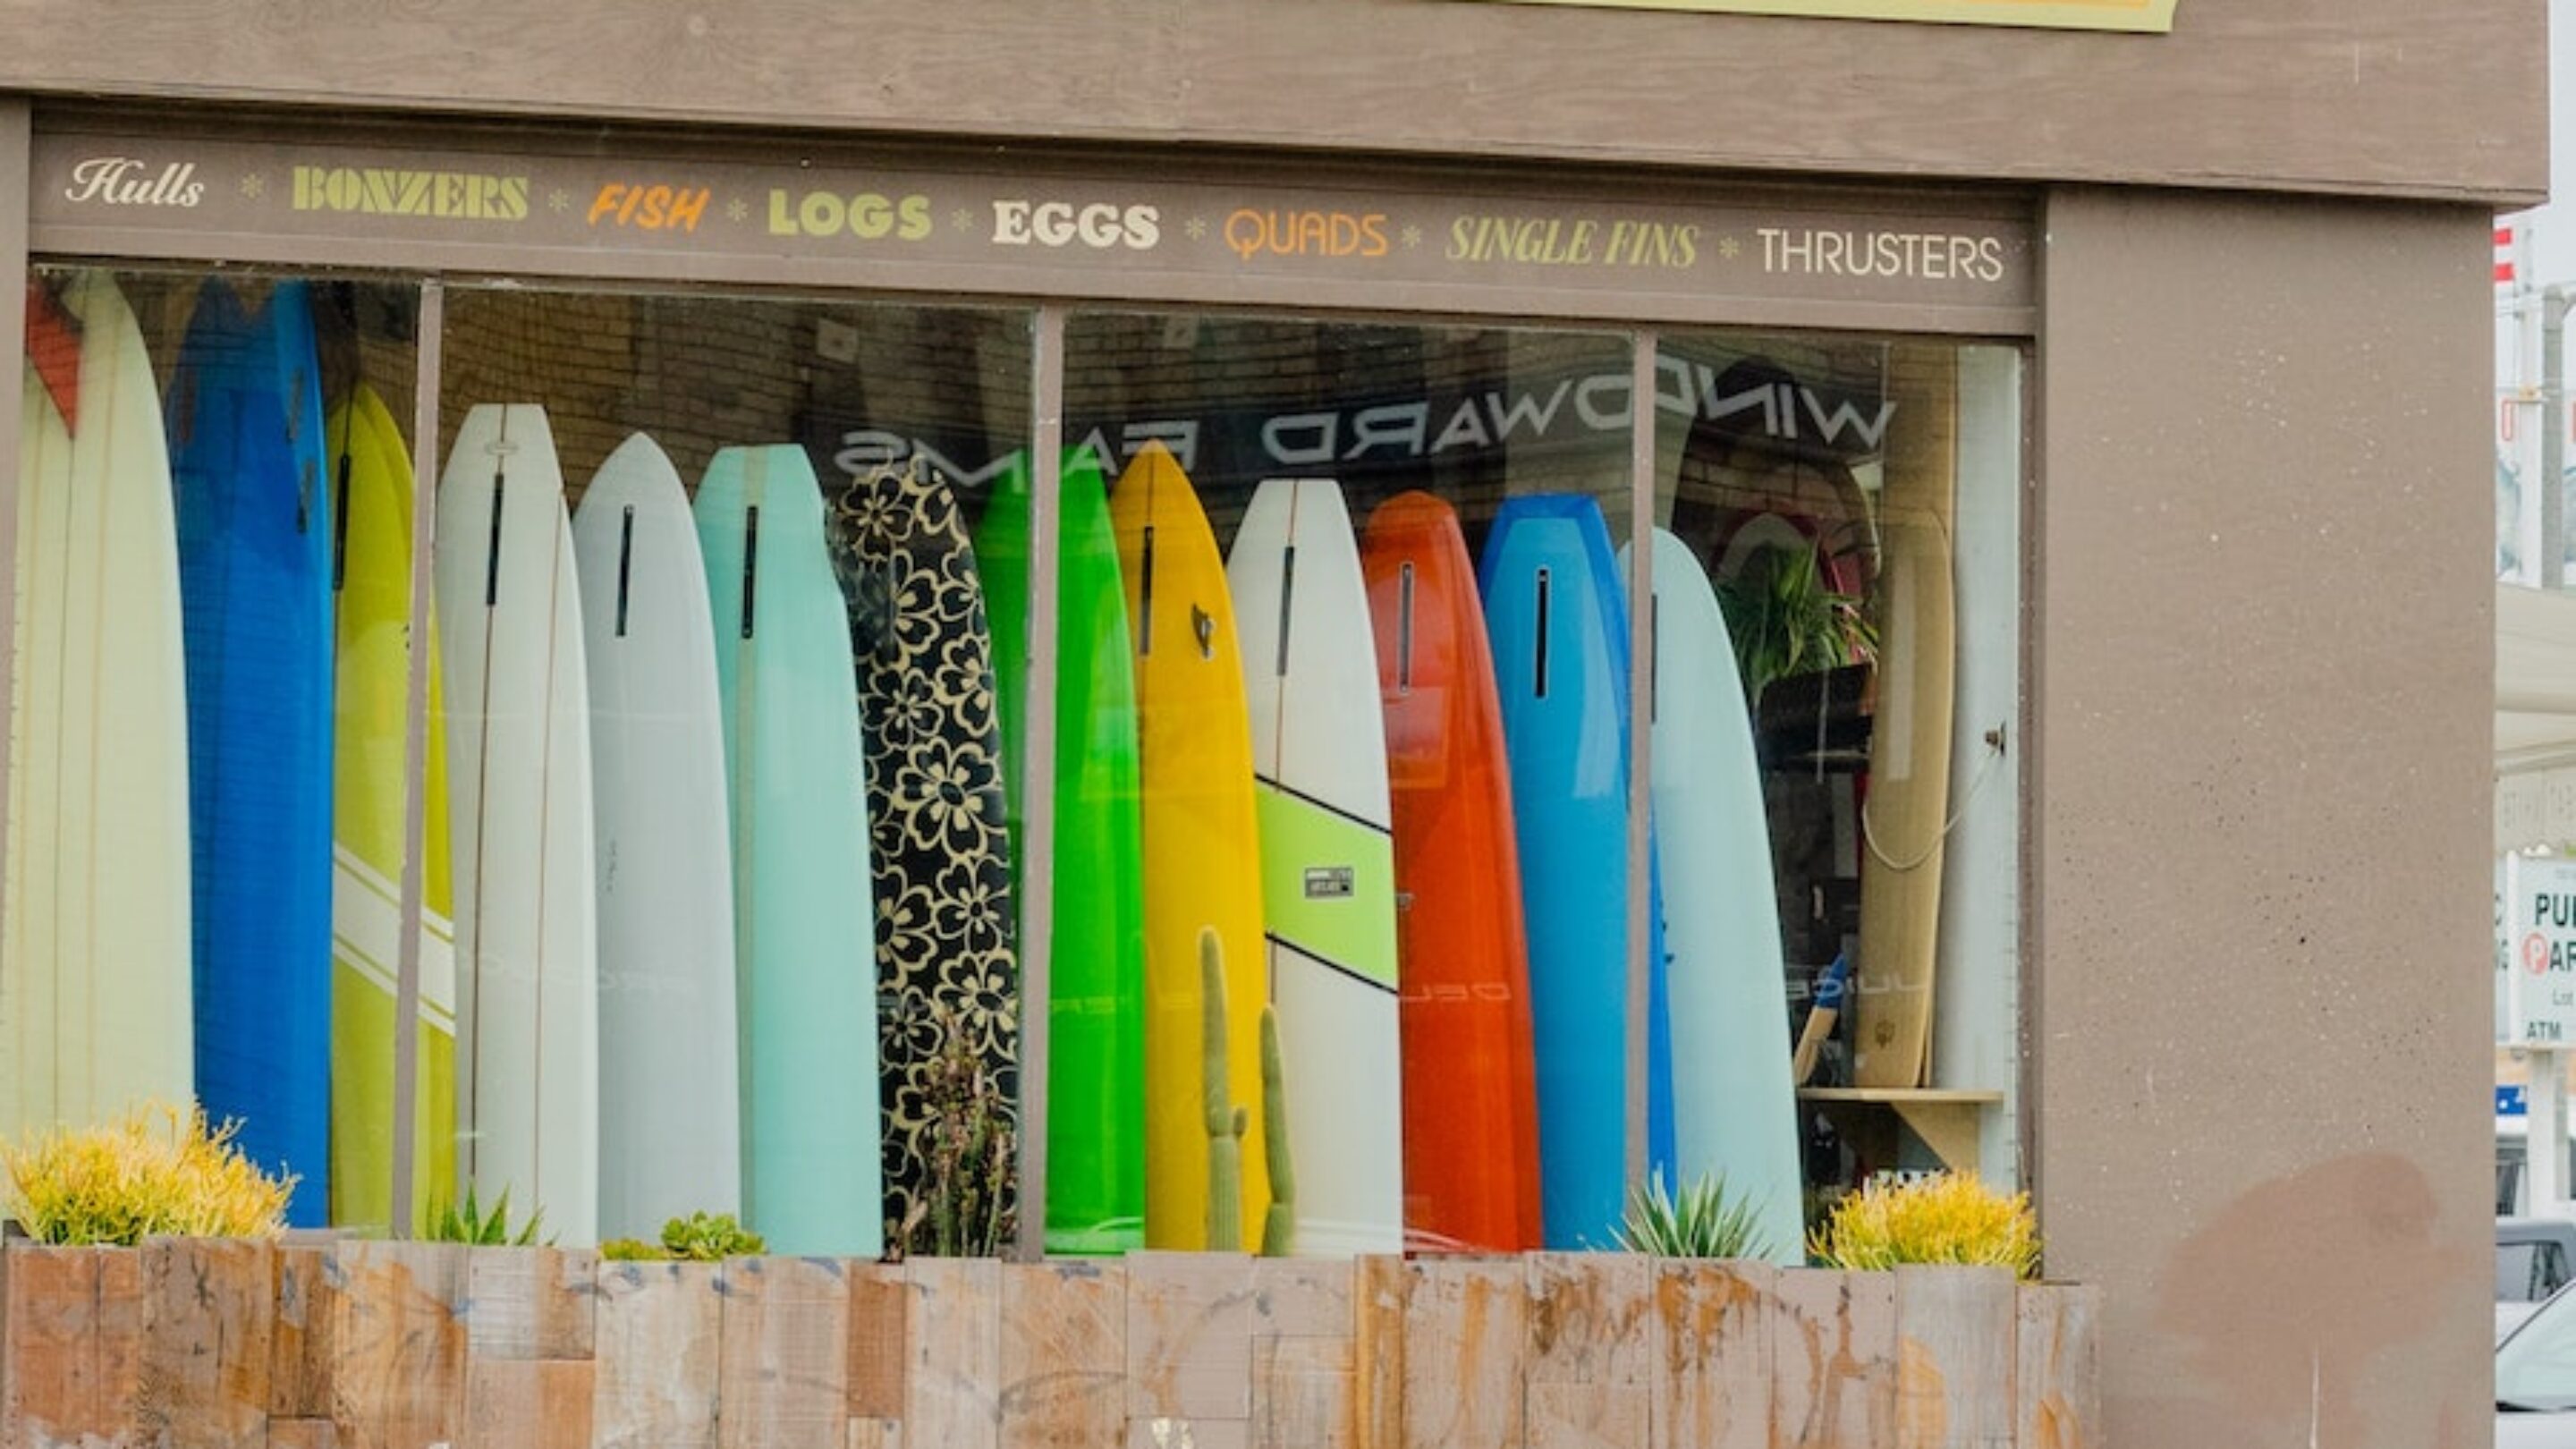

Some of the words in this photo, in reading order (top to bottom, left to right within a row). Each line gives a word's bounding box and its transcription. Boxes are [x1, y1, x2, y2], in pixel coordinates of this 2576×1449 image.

[64, 157, 207, 208] Hulls
[292, 165, 530, 221] BONZERS
[586, 183, 711, 233] FISH
[768, 189, 934, 242] LOGS
[990, 199, 1161, 250] EGGS
[1224, 209, 1389, 260] QUADS
[1444, 215, 1598, 265] SINGLE
[1603, 221, 1699, 269] FINS
[1756, 227, 2004, 282] THRUSTERS
[2527, 1021, 2561, 1040] ATM
